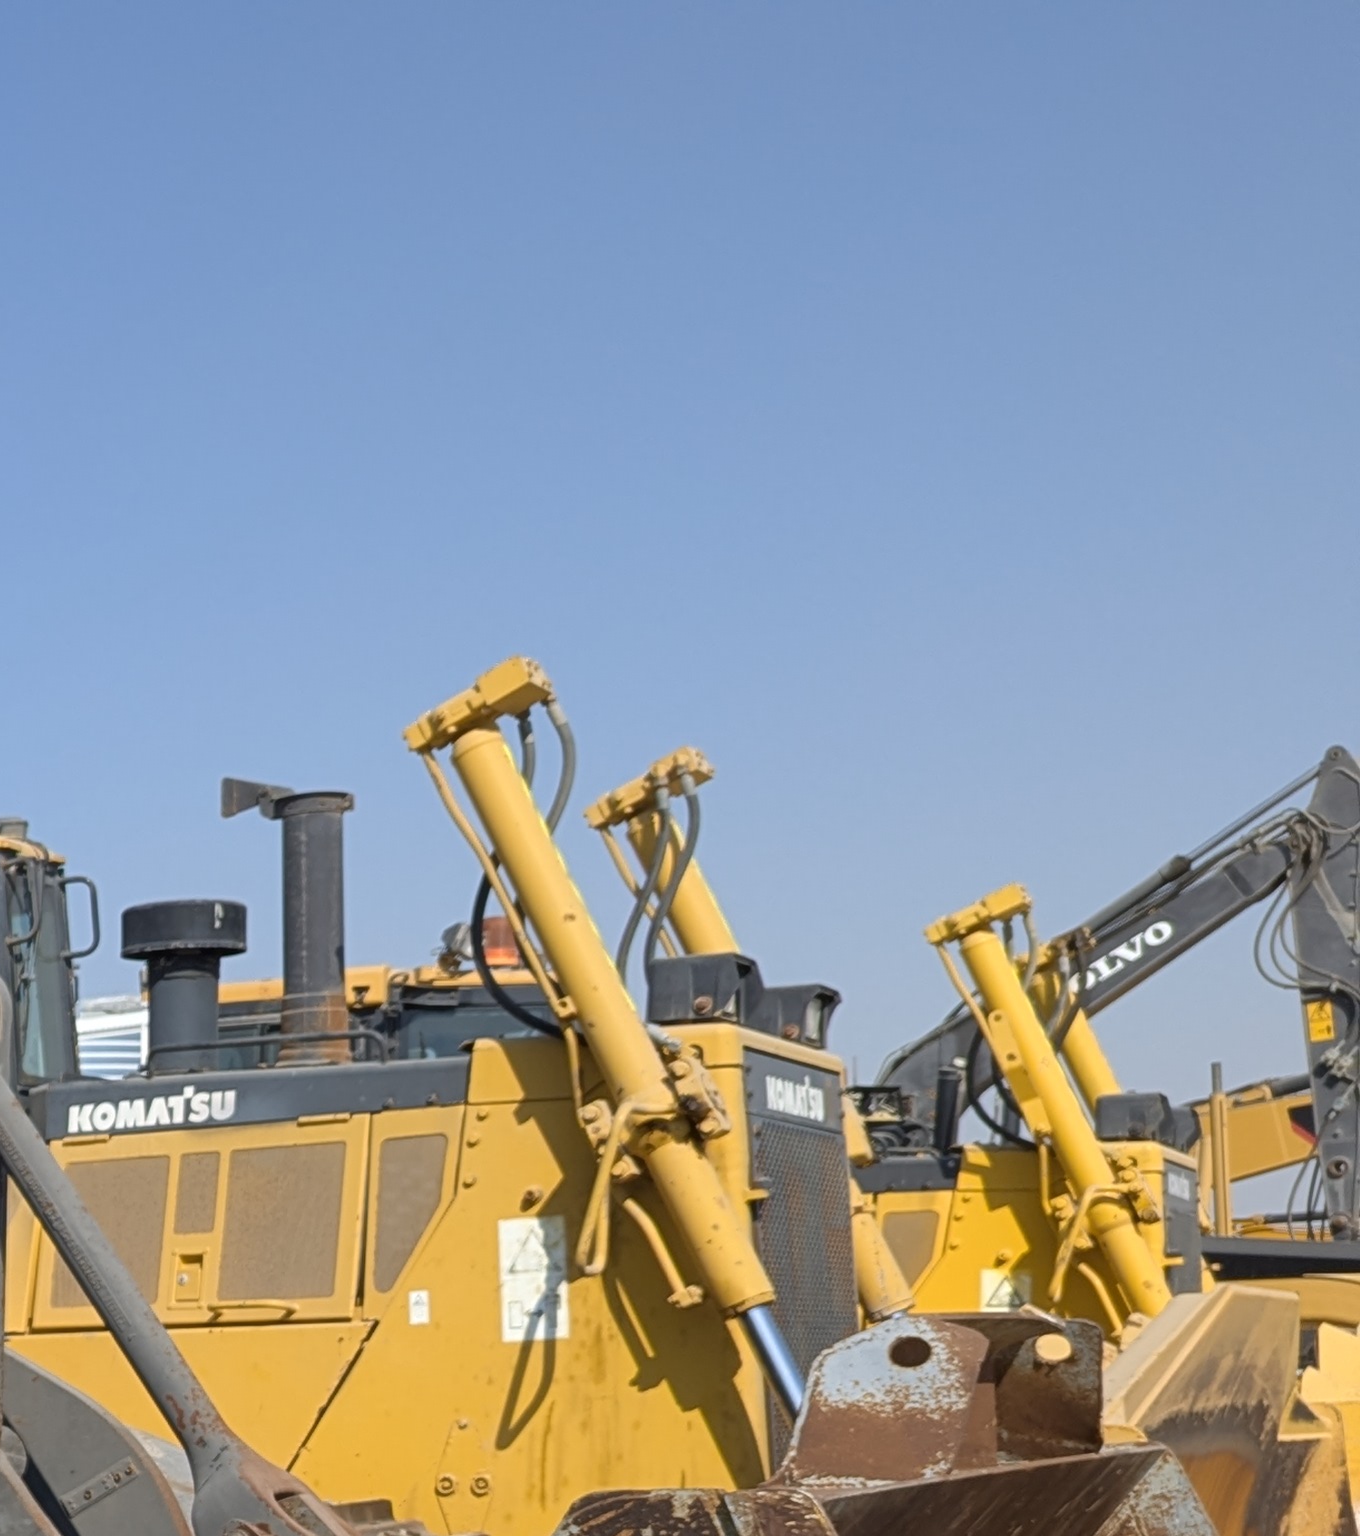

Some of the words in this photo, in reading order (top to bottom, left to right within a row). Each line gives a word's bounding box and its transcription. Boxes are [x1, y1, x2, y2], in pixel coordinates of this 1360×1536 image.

[1067, 921, 1173, 991] OLVO
[67, 1085, 236, 1133] KOMATSU
[765, 1074, 825, 1122] KOMATSU
